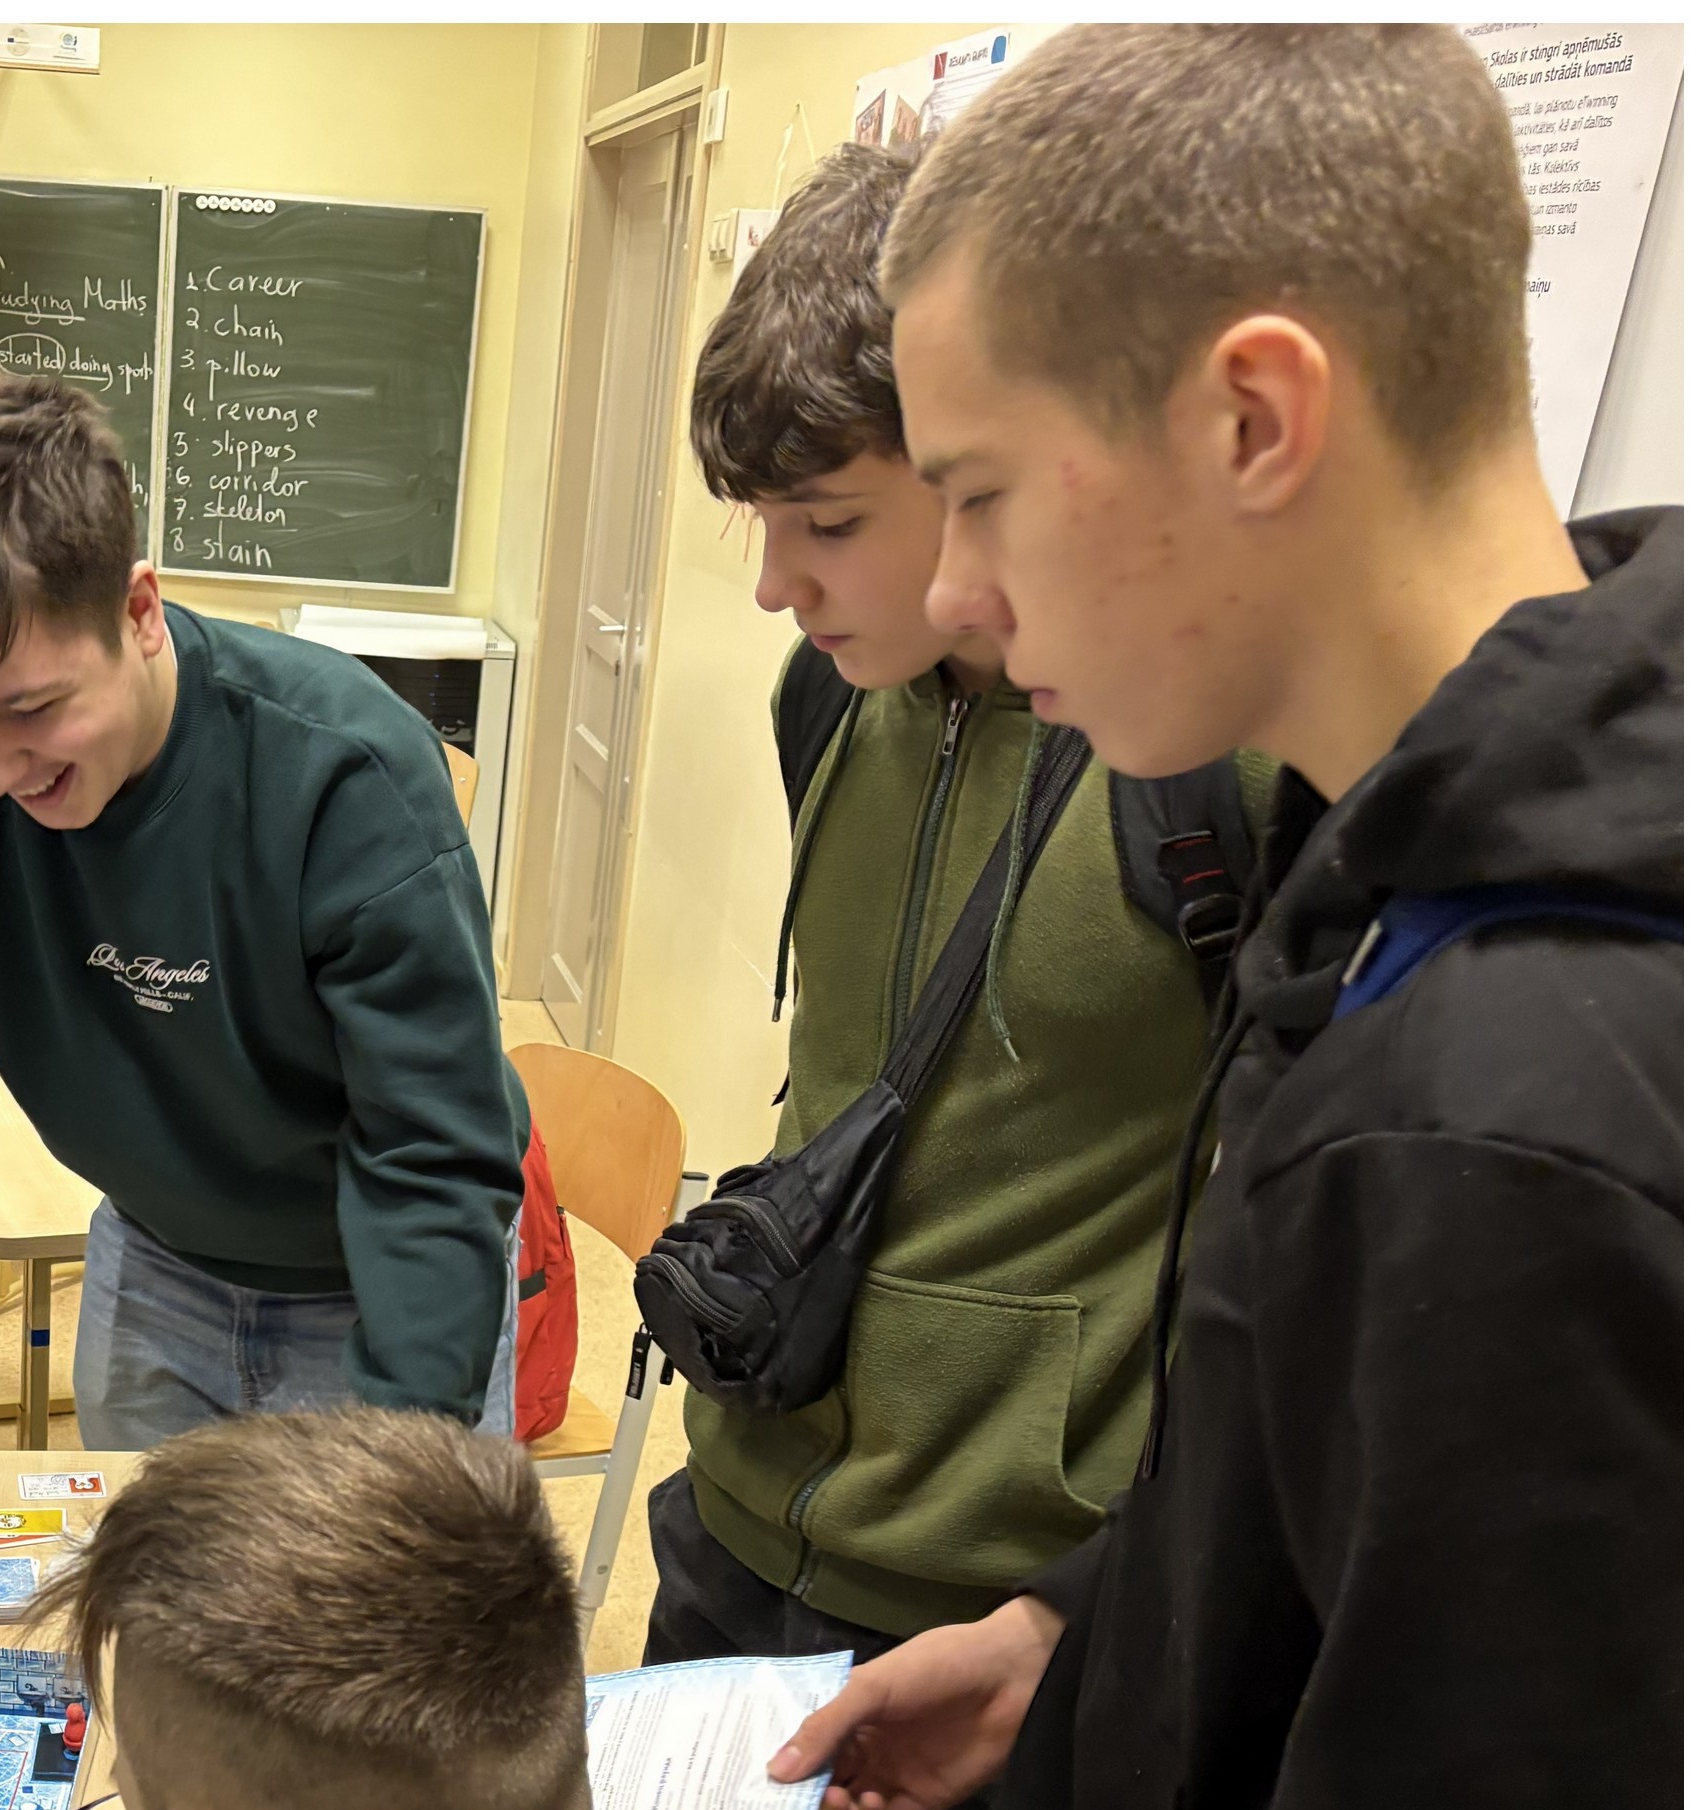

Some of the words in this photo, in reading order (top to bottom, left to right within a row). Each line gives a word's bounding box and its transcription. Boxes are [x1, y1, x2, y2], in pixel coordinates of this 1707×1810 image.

[1490, 47, 1518, 67] Skolas
[1529, 43, 1561, 62] stingri
[1530, 71, 1542, 83] un
[1545, 64, 1582, 82] strādāt
[1584, 54, 1633, 78] komandā
[207, 266, 303, 298] Career
[214, 304, 284, 346] chain
[69, 348, 113, 391] doing
[206, 351, 281, 400] pillow
[217, 402, 318, 431] revenge
[212, 430, 296, 471] slippers
[209, 468, 308, 497] corridor
[203, 494, 285, 526] skeleton
[203, 520, 272, 568] stain
[126, 956, 210, 990] Angeles
